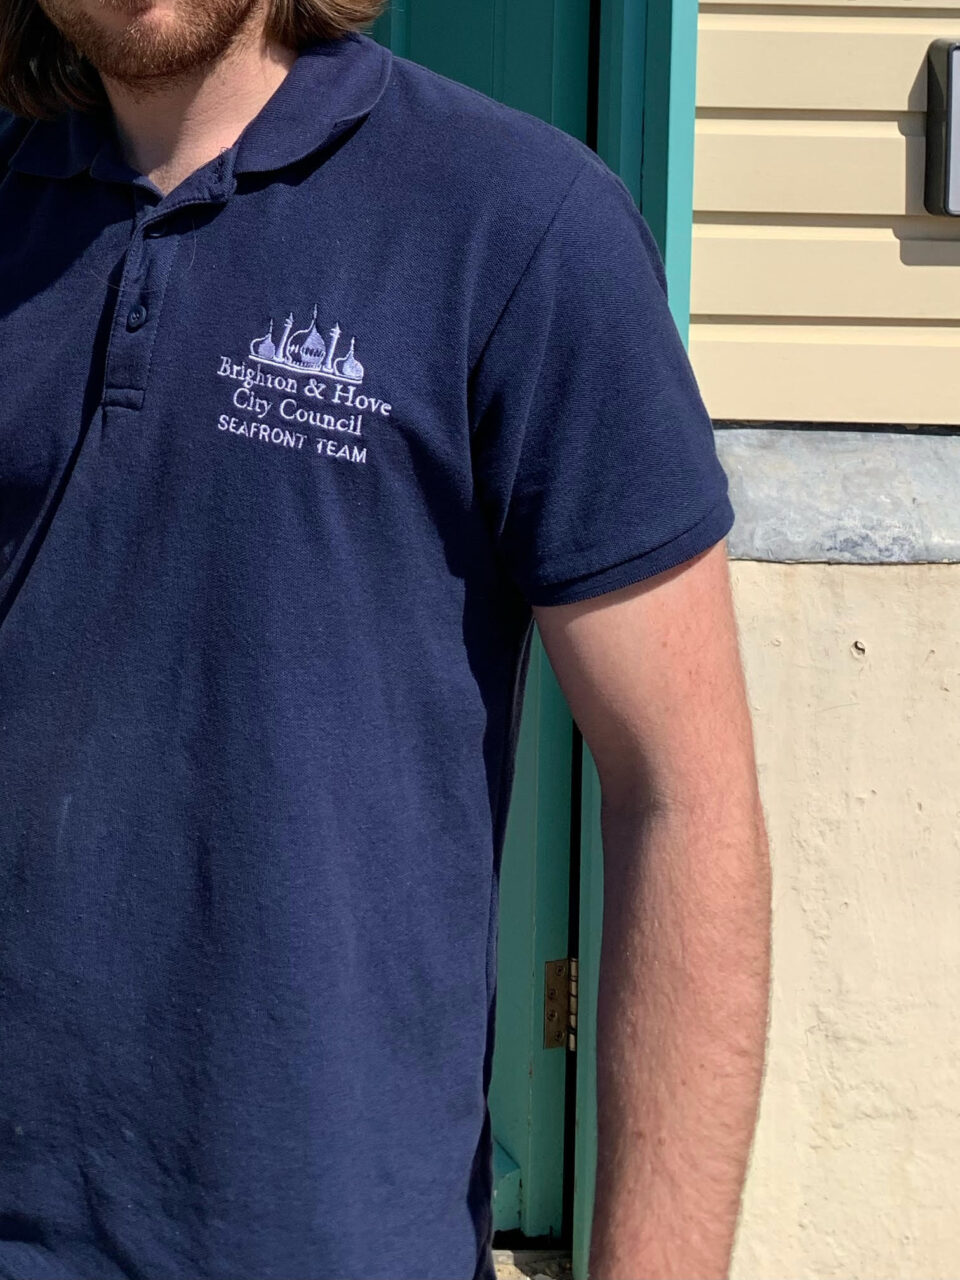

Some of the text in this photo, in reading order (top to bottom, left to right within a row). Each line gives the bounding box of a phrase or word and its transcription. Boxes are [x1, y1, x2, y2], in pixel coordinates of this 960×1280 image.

[217, 355, 392, 416] Brighton & Hove
[233, 387, 363, 436] City Council
[217, 414, 368, 464] SEAFRONT TEAM
